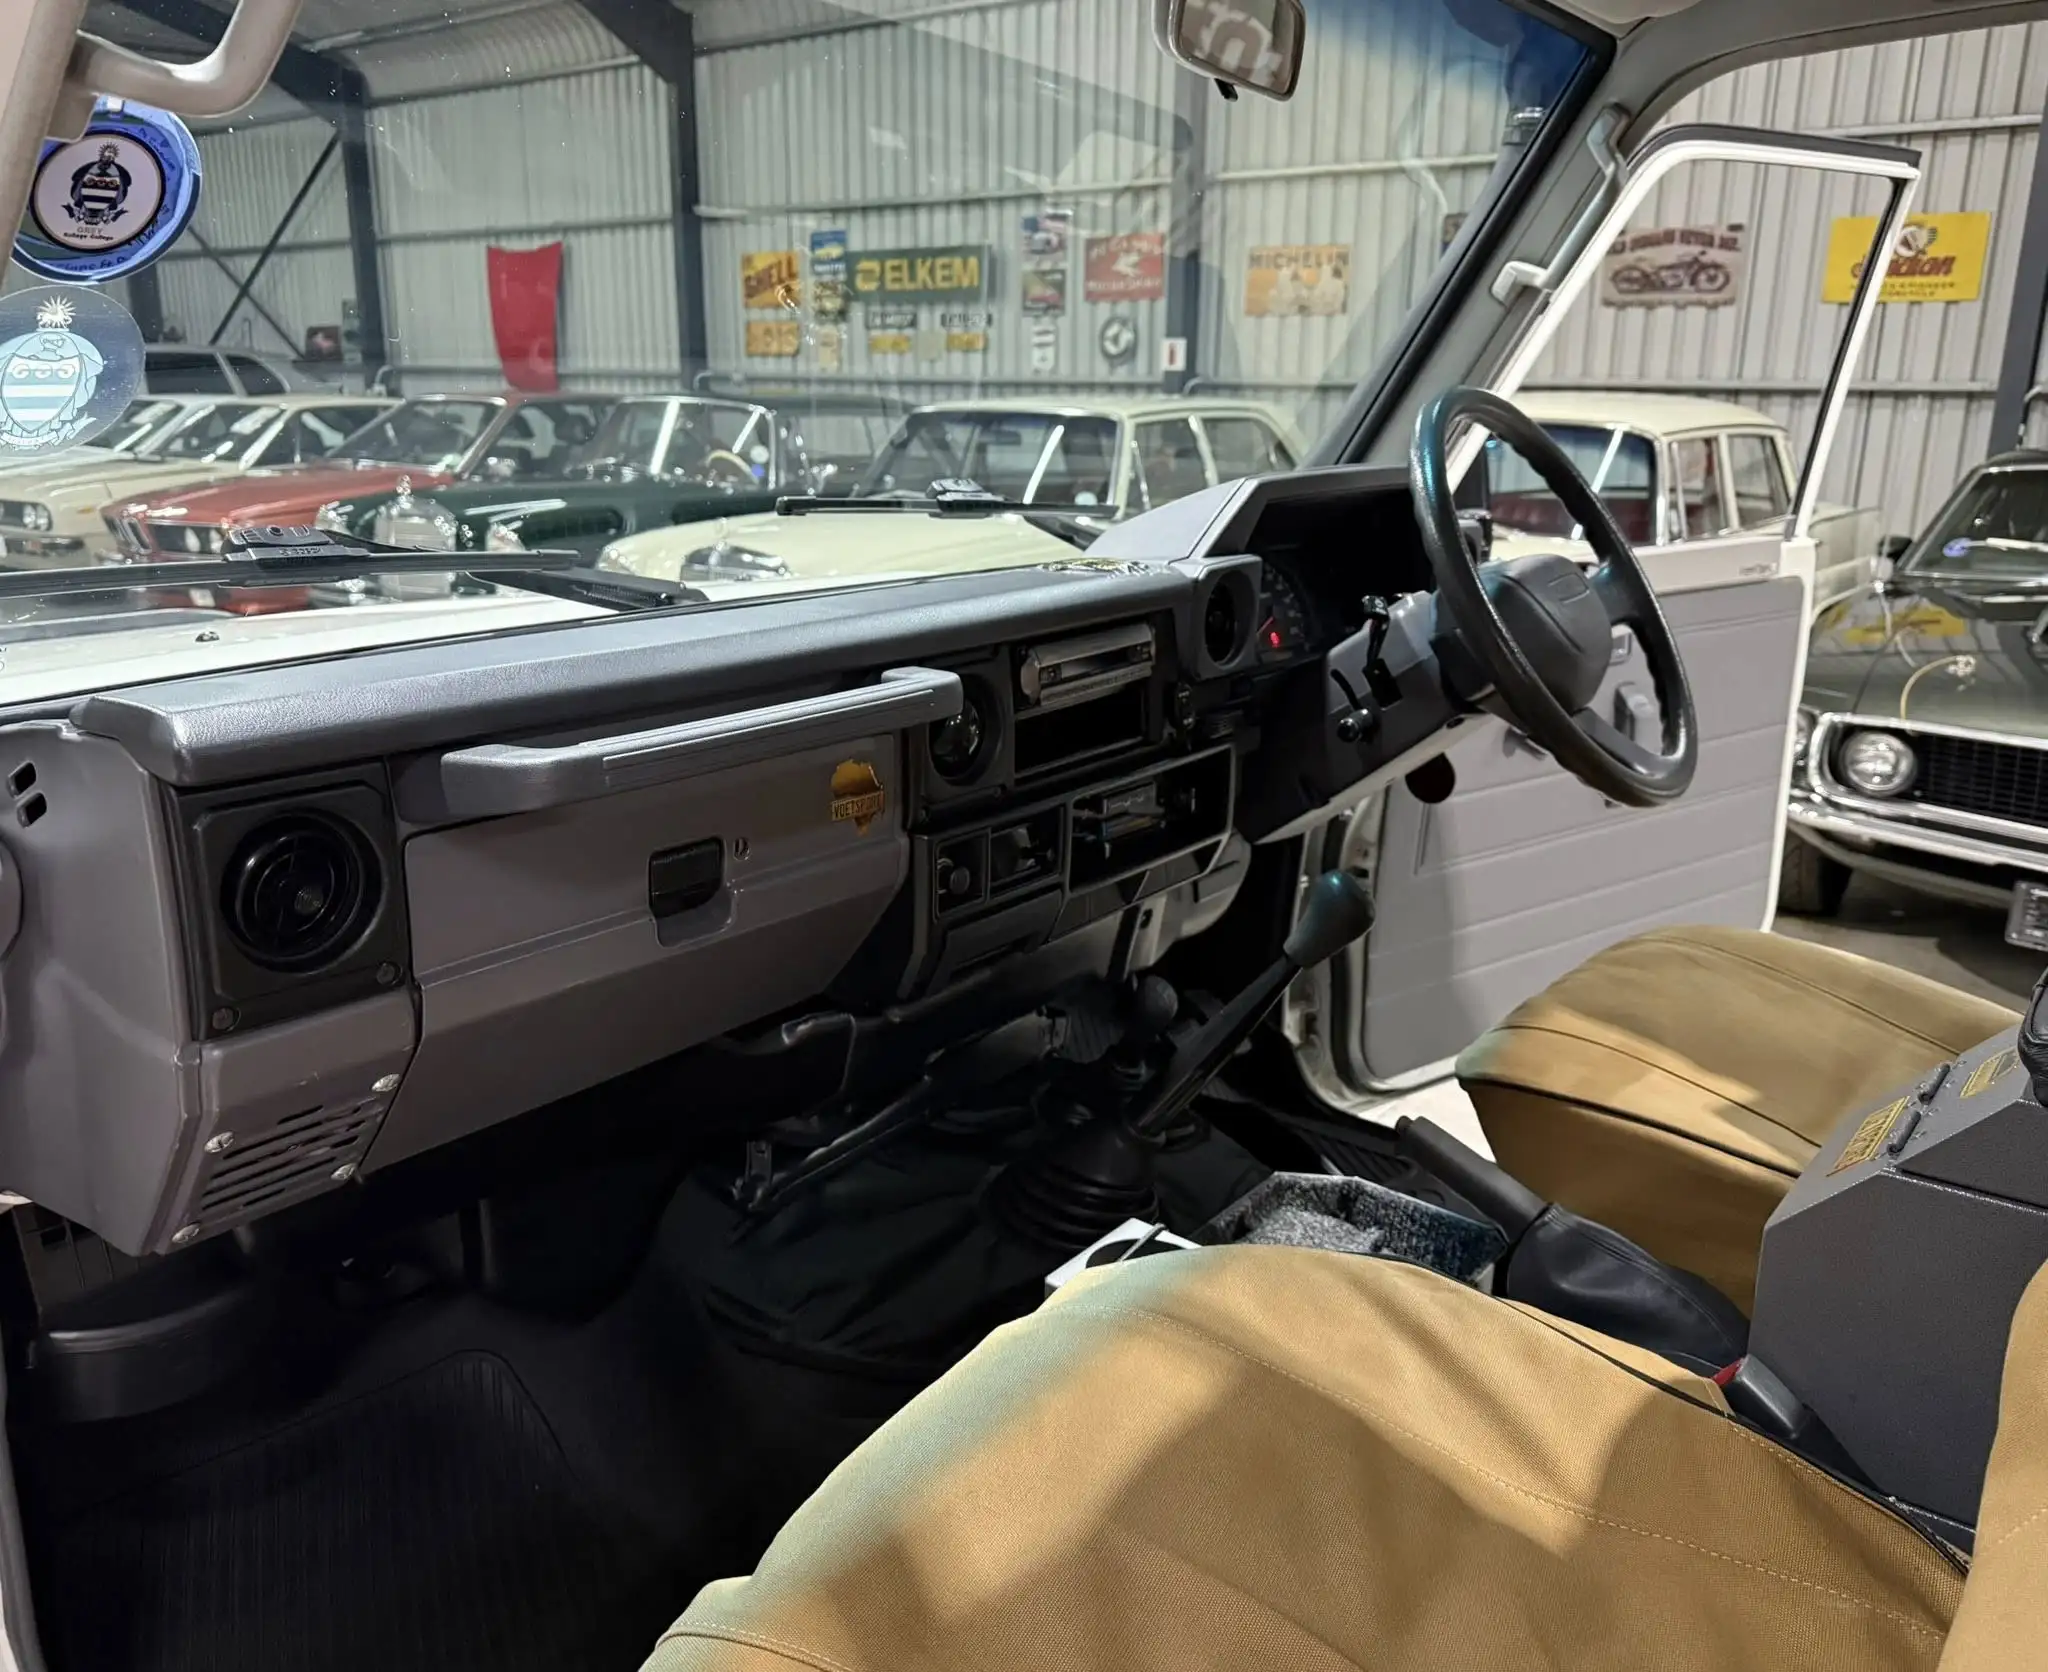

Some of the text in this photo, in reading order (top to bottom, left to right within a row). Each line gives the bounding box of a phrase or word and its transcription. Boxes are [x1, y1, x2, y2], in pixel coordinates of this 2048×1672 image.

[77, 226, 103, 234] GREY
[1248, 250, 1350, 269] MICHELIN
[744, 255, 798, 299] SHELL
[884, 256, 980, 291] ELKEM
